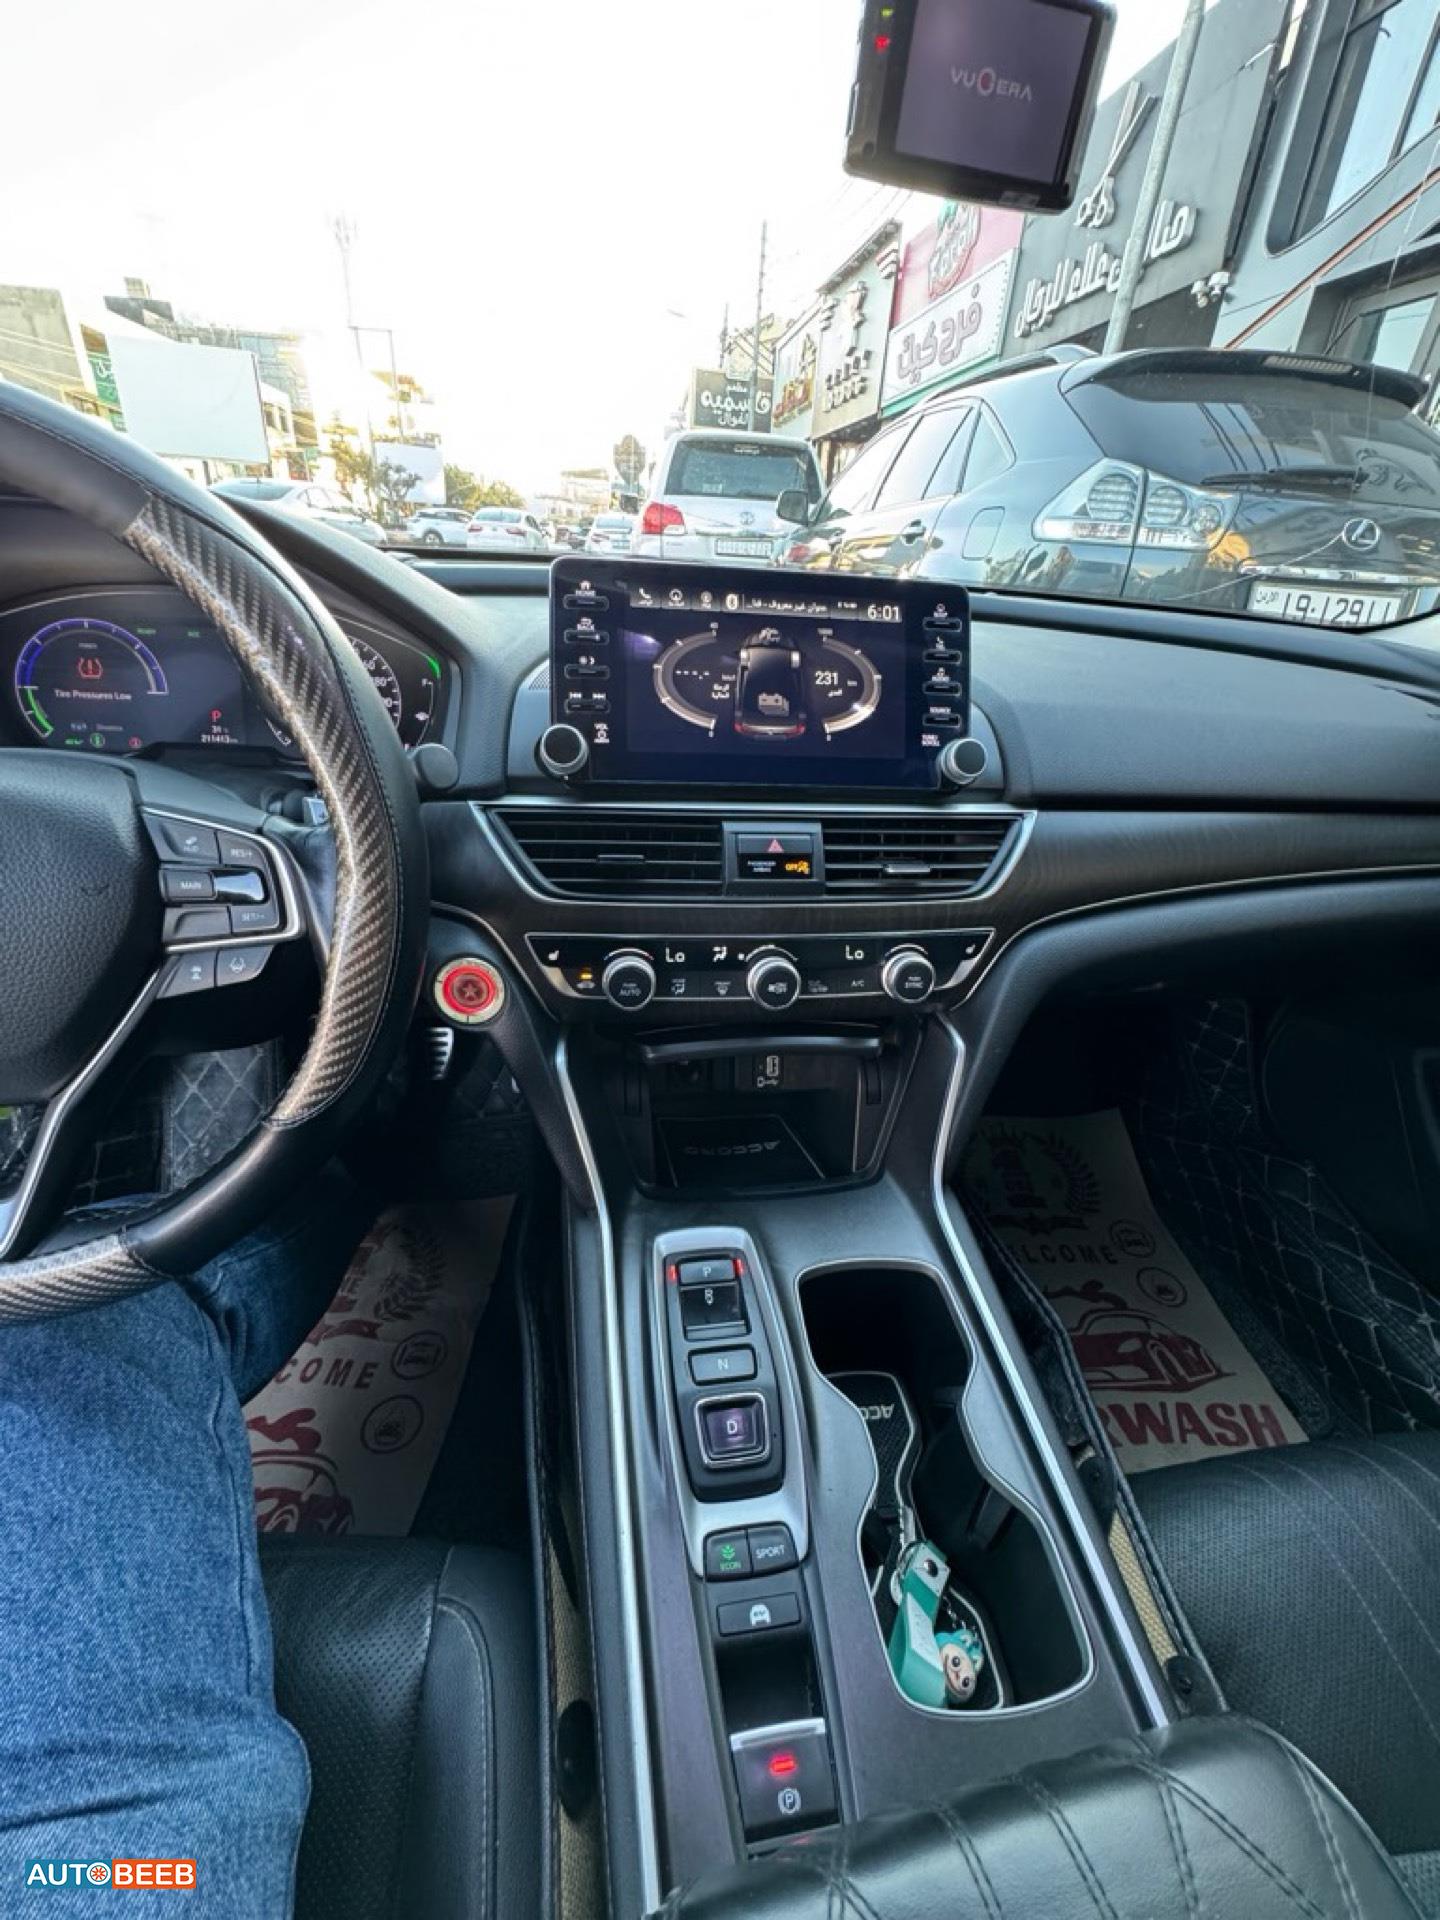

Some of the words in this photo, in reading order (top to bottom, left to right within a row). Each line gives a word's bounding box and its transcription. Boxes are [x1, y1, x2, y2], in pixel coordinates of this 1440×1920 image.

[867, 605, 900, 621] 6:01
[815, 671, 839, 685] 231
[210, 710, 222, 722] P
[180, 881, 202, 890] MAIN
[665, 946, 685, 963] Lo
[845, 945, 865, 960] Lo
[619, 988, 642, 997] AUTO
[702, 1266, 712, 1278] P
[717, 1358, 729, 1371] N
[726, 1419, 739, 1434] D
[755, 1544, 785, 1559] SPORT
[720, 1560, 742, 1572] ECON
